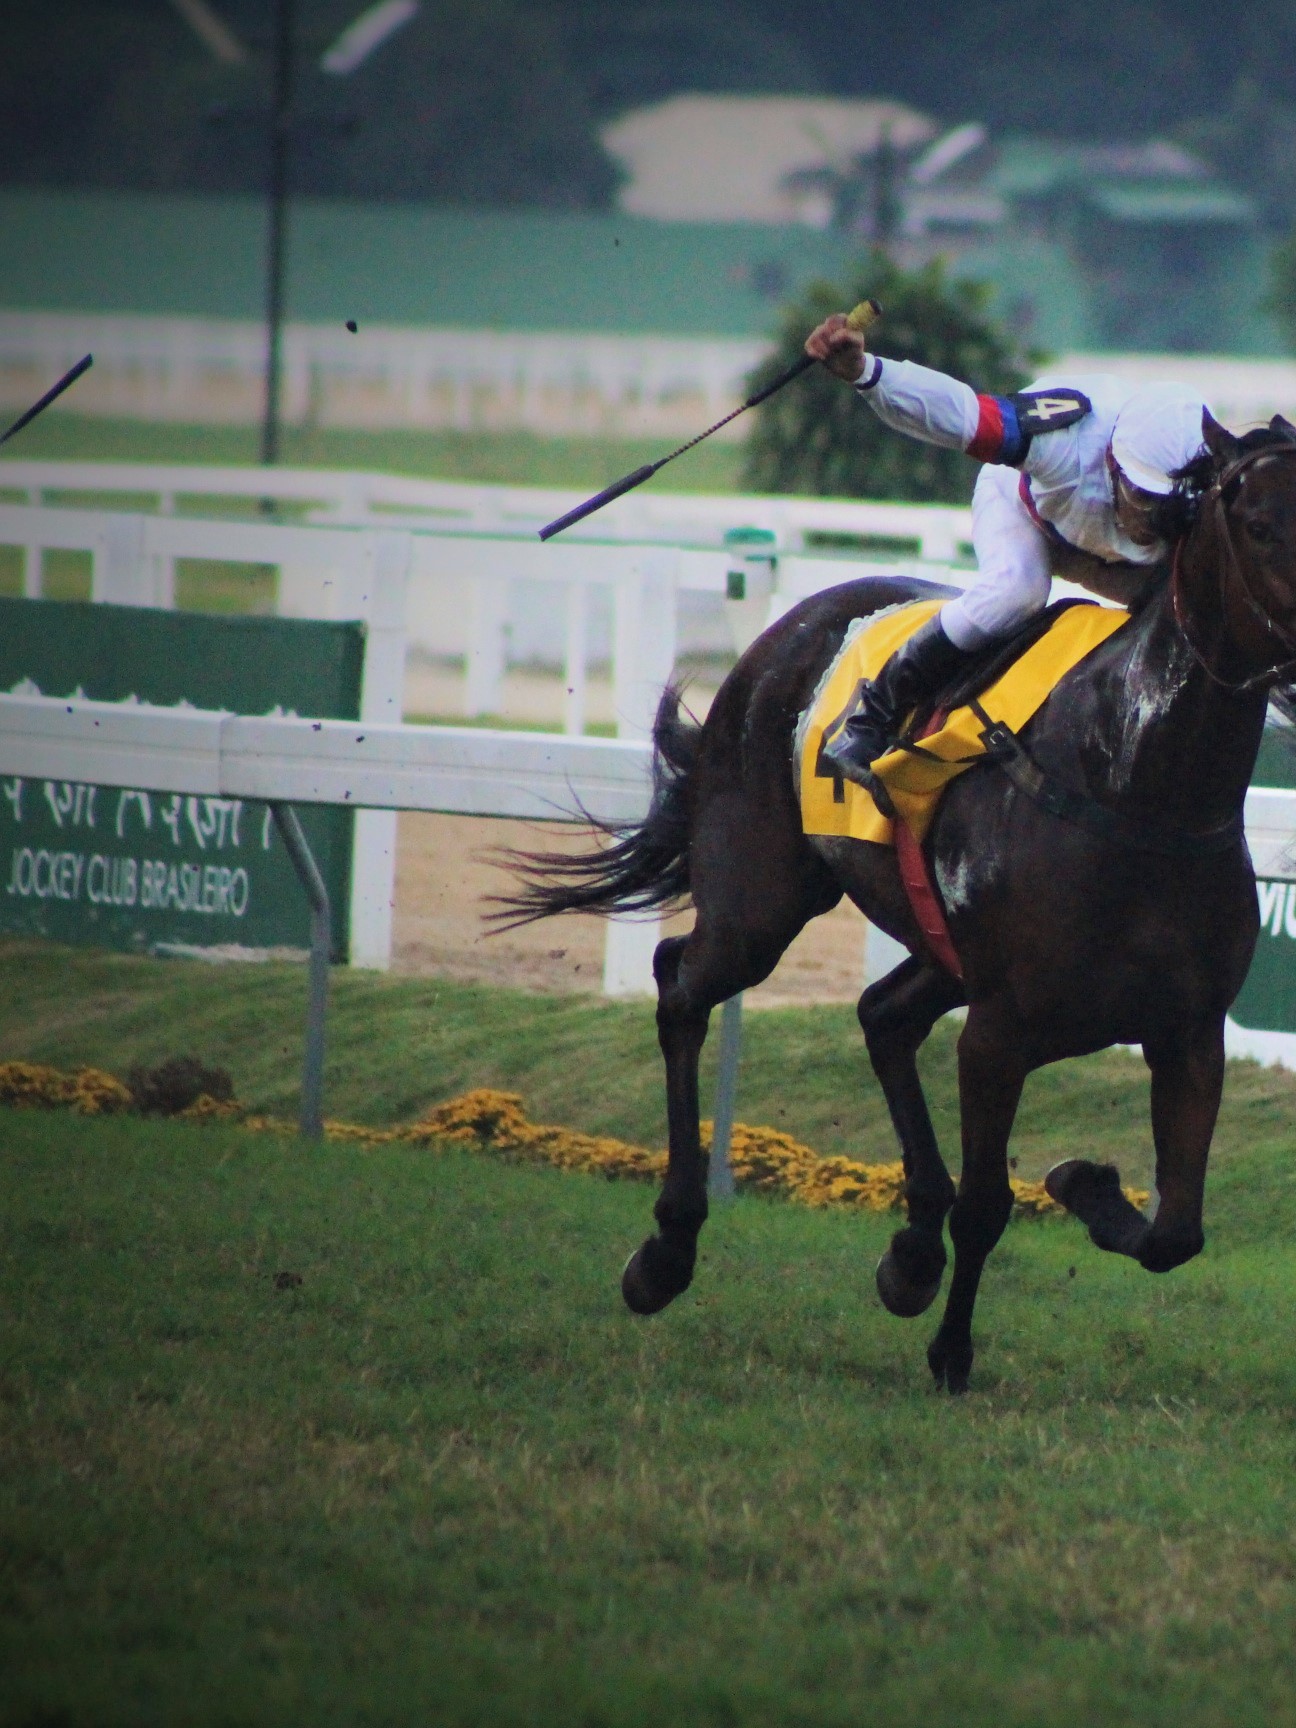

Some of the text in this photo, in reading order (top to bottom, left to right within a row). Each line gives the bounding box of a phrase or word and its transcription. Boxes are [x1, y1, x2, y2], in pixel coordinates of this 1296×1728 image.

[1028, 397, 1081, 421] 4
[7, 847, 249, 917] JOCKEY CLUB BRASILEIRO
